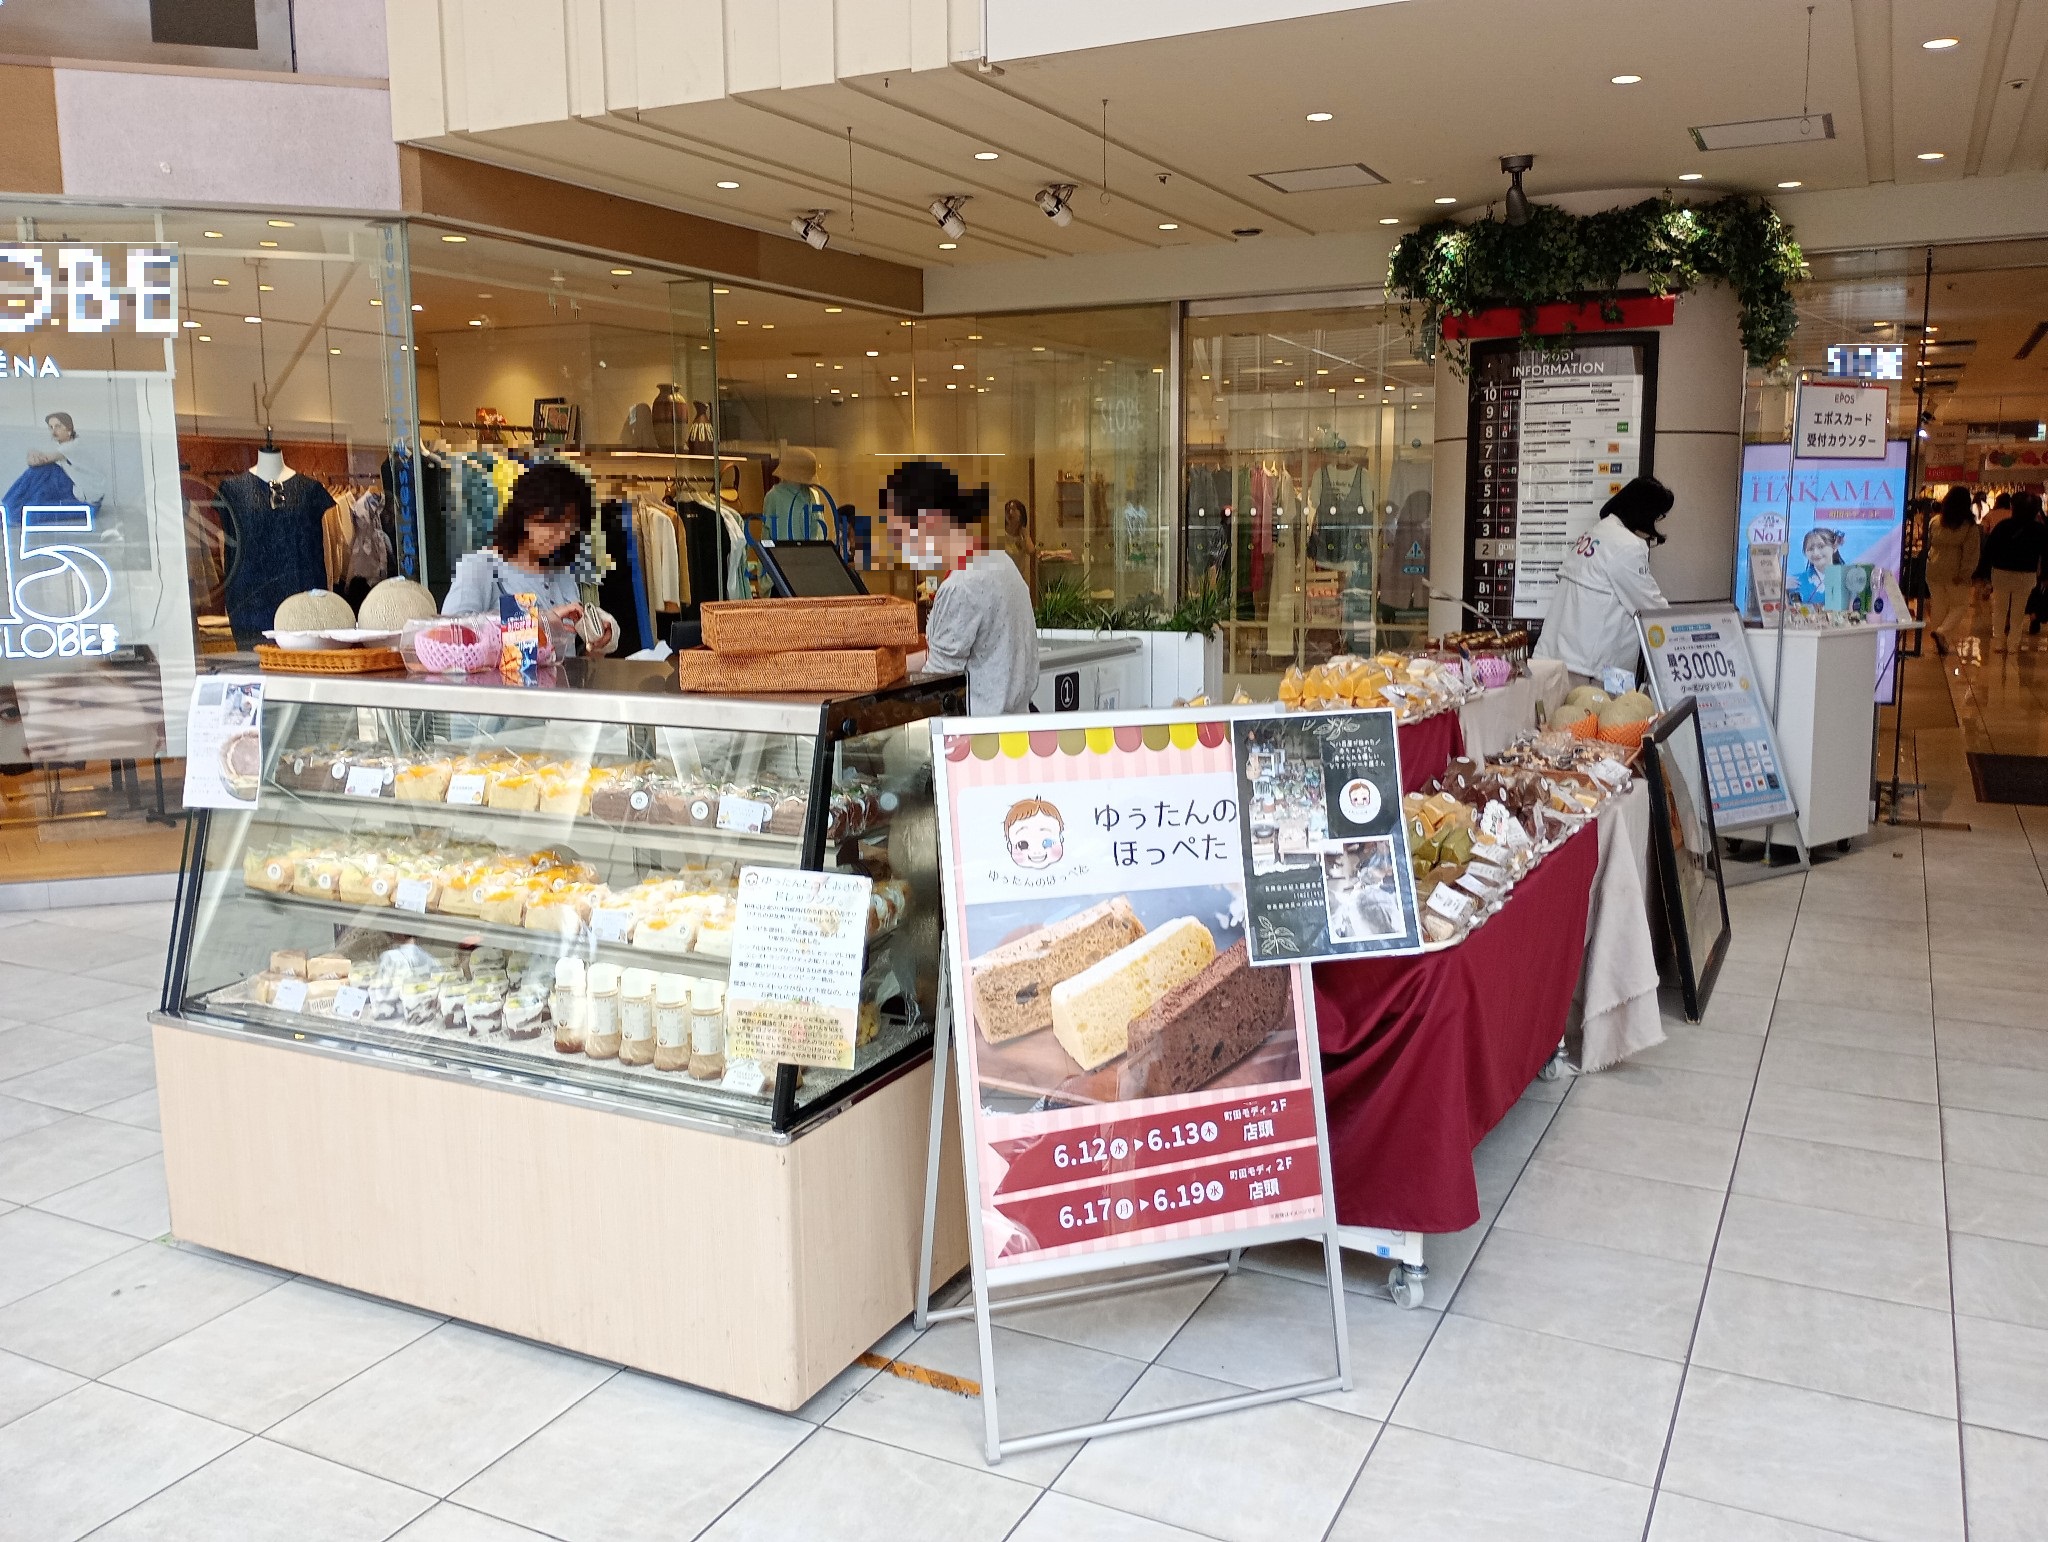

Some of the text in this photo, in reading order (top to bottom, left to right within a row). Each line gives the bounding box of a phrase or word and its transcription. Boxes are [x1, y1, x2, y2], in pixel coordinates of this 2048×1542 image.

[1512, 362, 1604, 378] INFORMATION
[1483, 388, 1497, 402] 10
[1834, 393, 1855, 404] EPOS
[1486, 405, 1494, 419] 9
[1485, 425, 1493, 439] 8
[1806, 433, 1876, 447] 受付カウンター
[1484, 444, 1493, 458] 7
[1484, 465, 1492, 478] 6
[1483, 485, 1491, 498] 5
[1752, 480, 1894, 502] HAKAMA
[1482, 503, 1490, 517] 4
[1482, 523, 1490, 536] 3
[1754, 528, 1783, 542] No.1
[1481, 544, 1489, 556] 2
[1482, 563, 1488, 575] 1
[1478, 582, 1490, 594] B1
[1477, 601, 1490, 613] B2
[1113, 833, 1228, 867] ほっぺた
[1223, 1098, 1287, 1122] 町田モディ 2F
[1243, 1119, 1275, 1142] 店頭
[1229, 1156, 1292, 1180] 町田モディ 2F
[1248, 1177, 1280, 1201] 店頭
